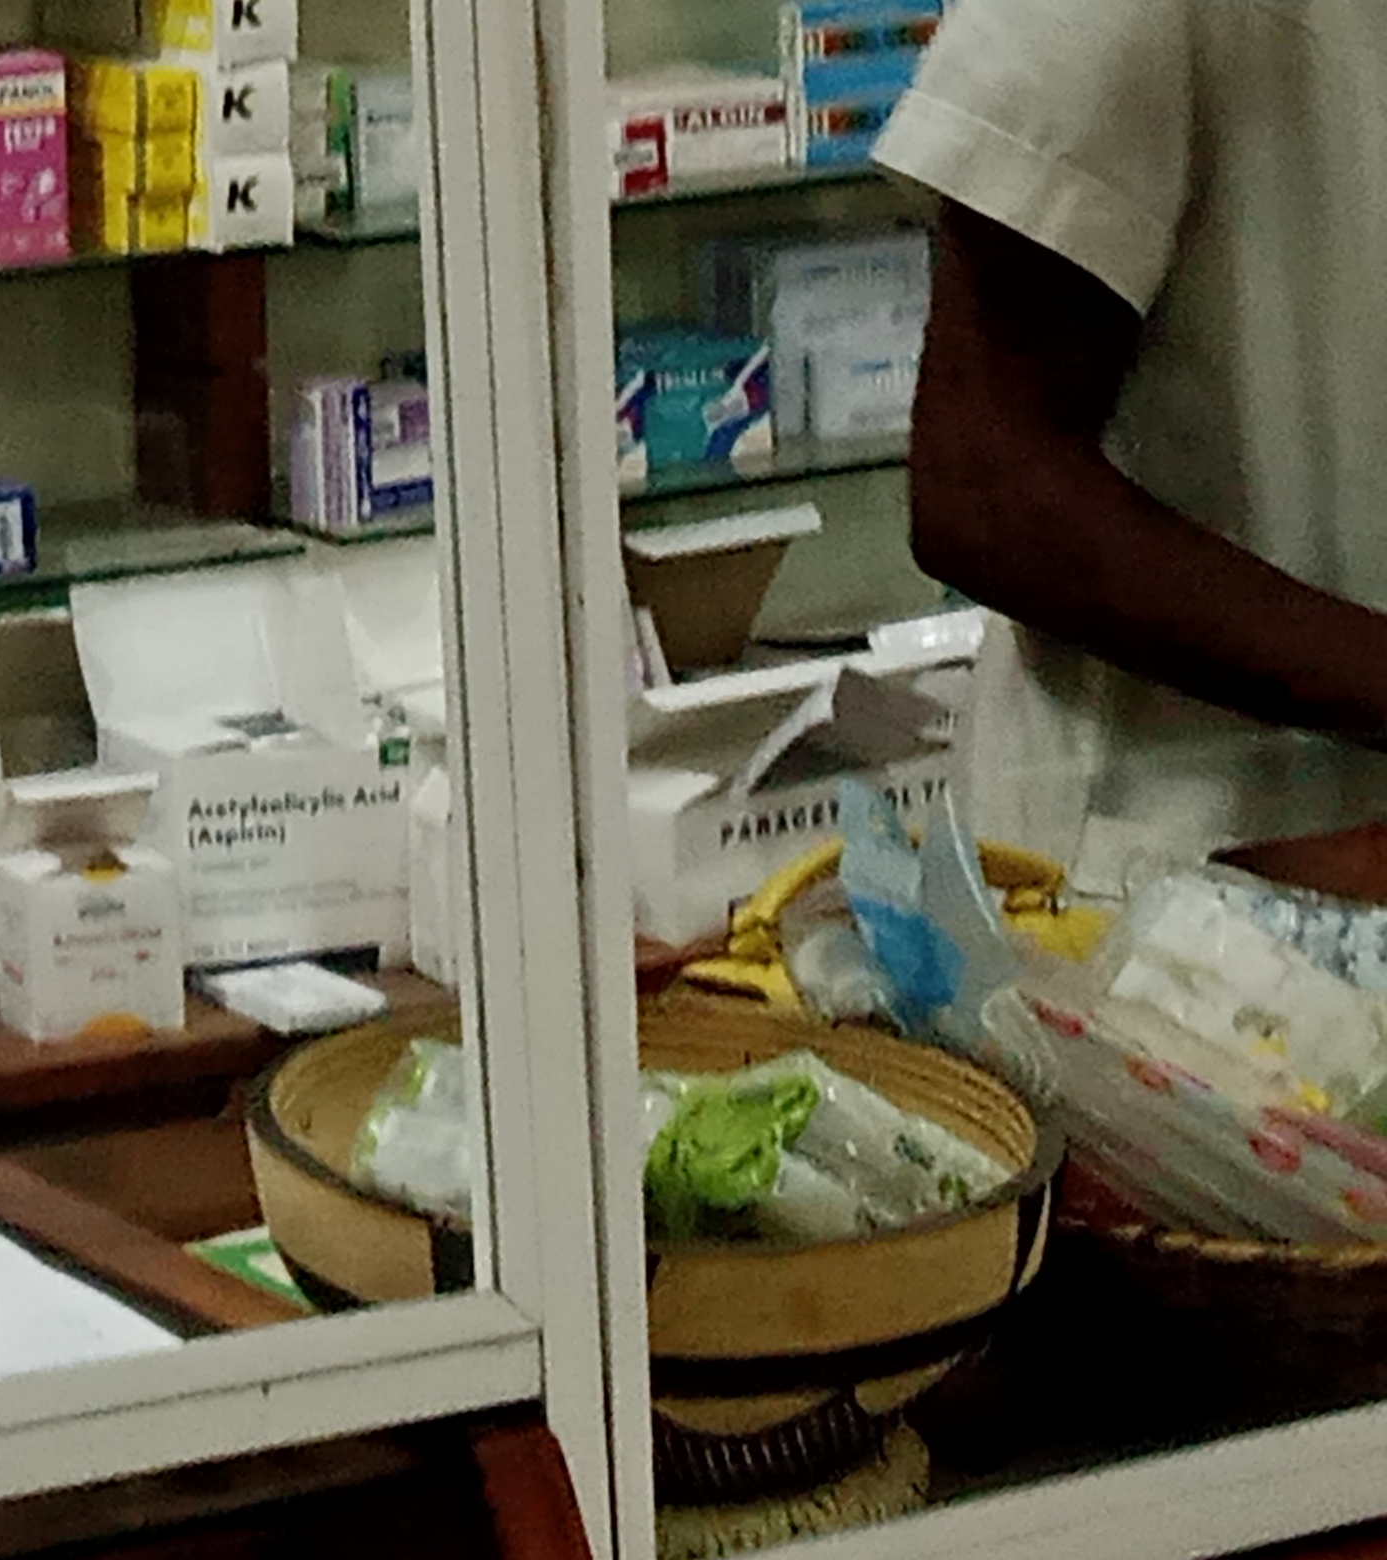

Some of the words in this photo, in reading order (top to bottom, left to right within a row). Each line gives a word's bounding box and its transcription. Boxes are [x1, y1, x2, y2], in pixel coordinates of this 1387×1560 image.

[221, 86, 254, 122] K
[227, 178, 259, 213] K
[352, 780, 402, 809] Acid
